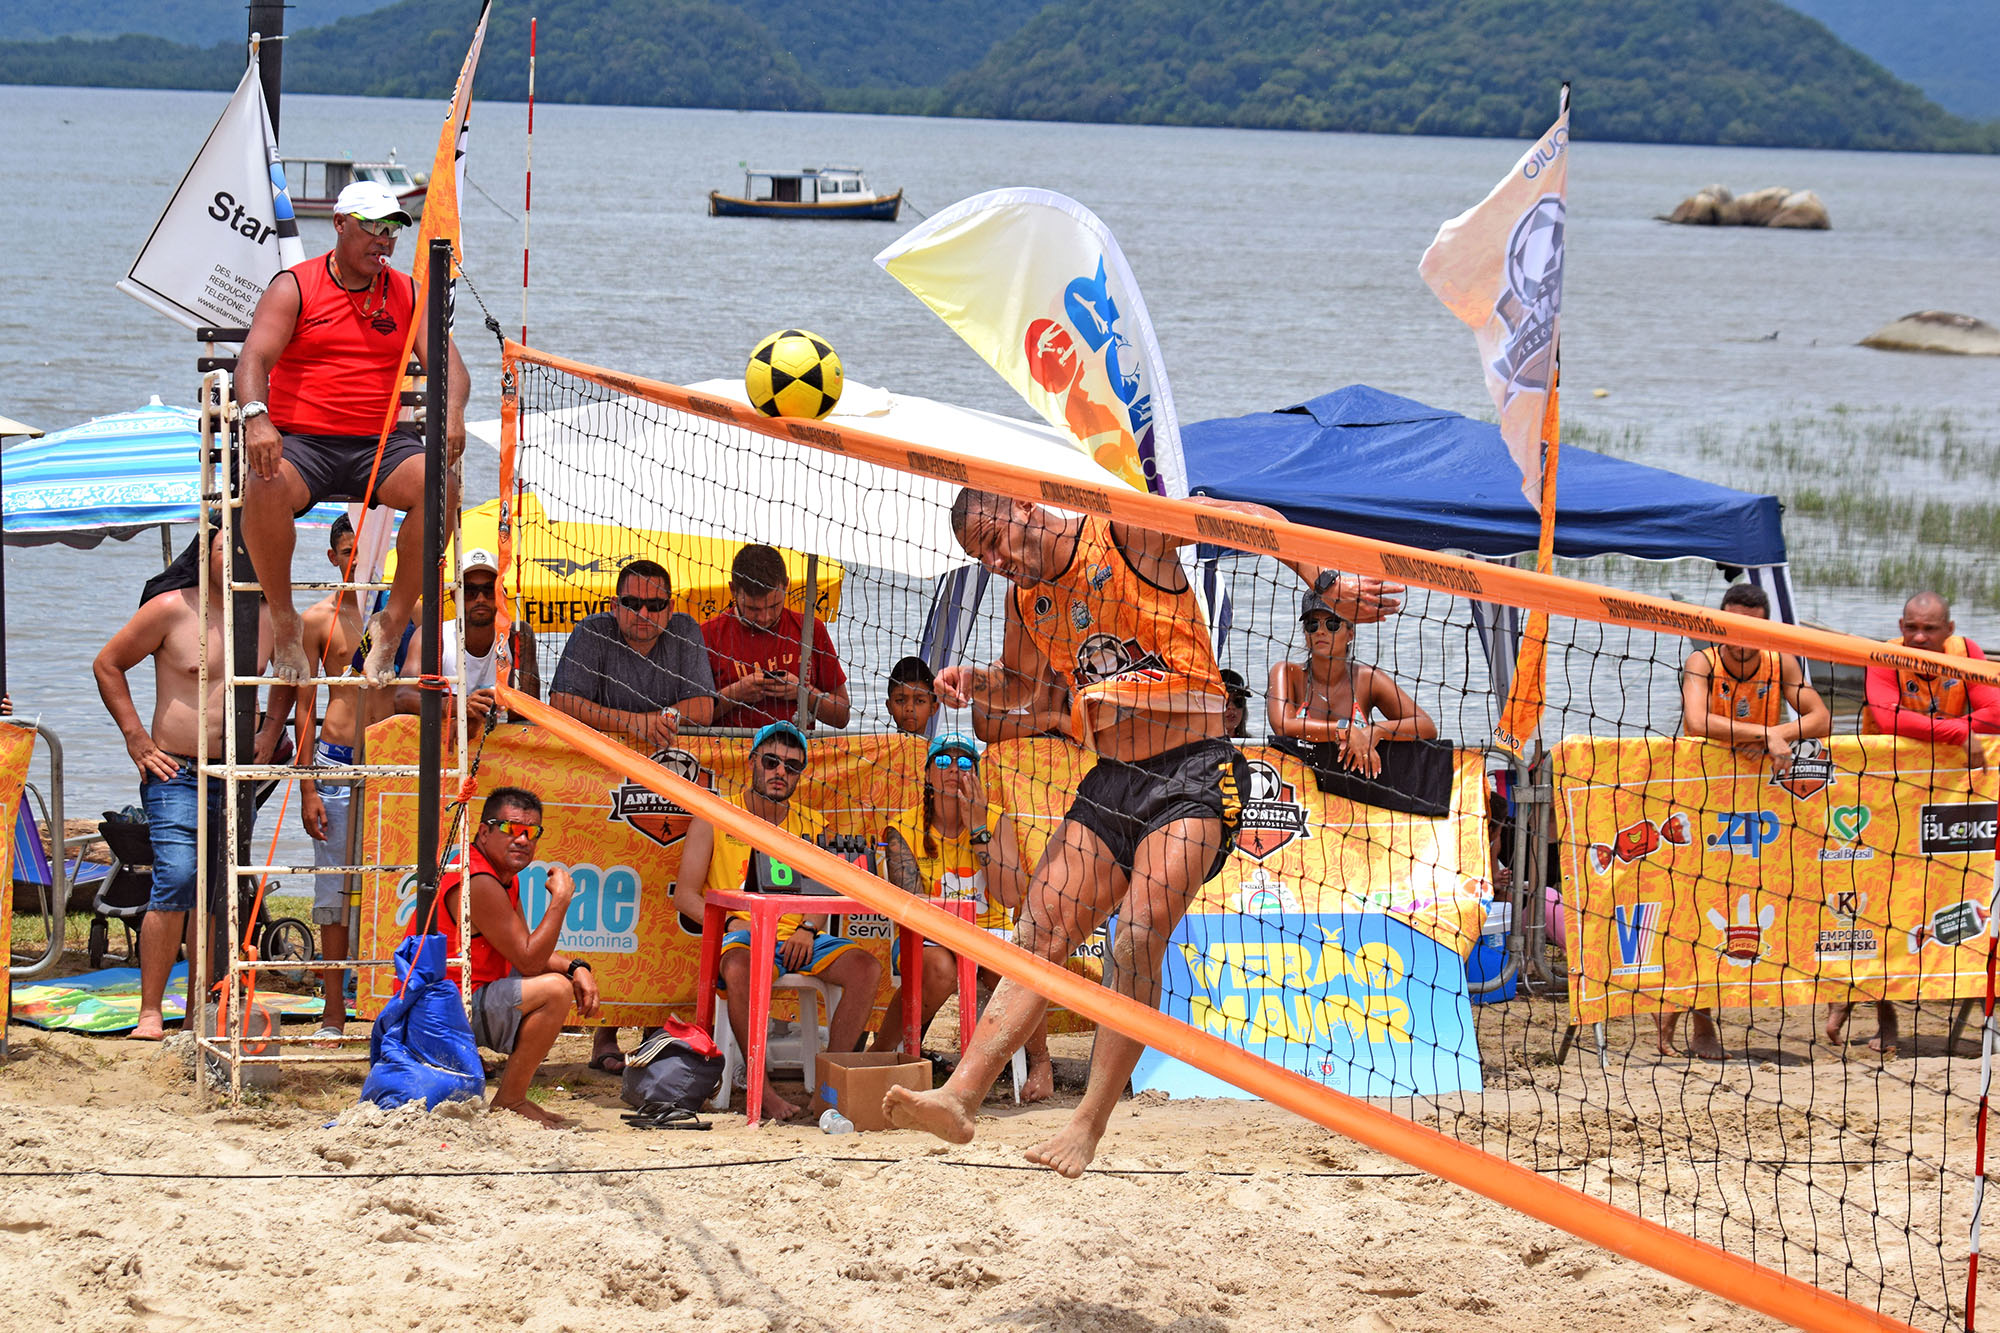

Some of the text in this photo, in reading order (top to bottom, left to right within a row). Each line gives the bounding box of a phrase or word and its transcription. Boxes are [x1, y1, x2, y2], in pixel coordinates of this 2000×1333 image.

[208, 191, 277, 245] Star
[214, 264, 231, 278] DES.
[204, 285, 246, 313] TELEFONE:
[209, 275, 252, 302] REBOUÇAS
[1819, 848, 1873, 859] Real Brasil
[1837, 892, 1856, 914] K
[1177, 924, 1404, 989] VERÃO
[1190, 994, 1412, 1044] MAIOR
